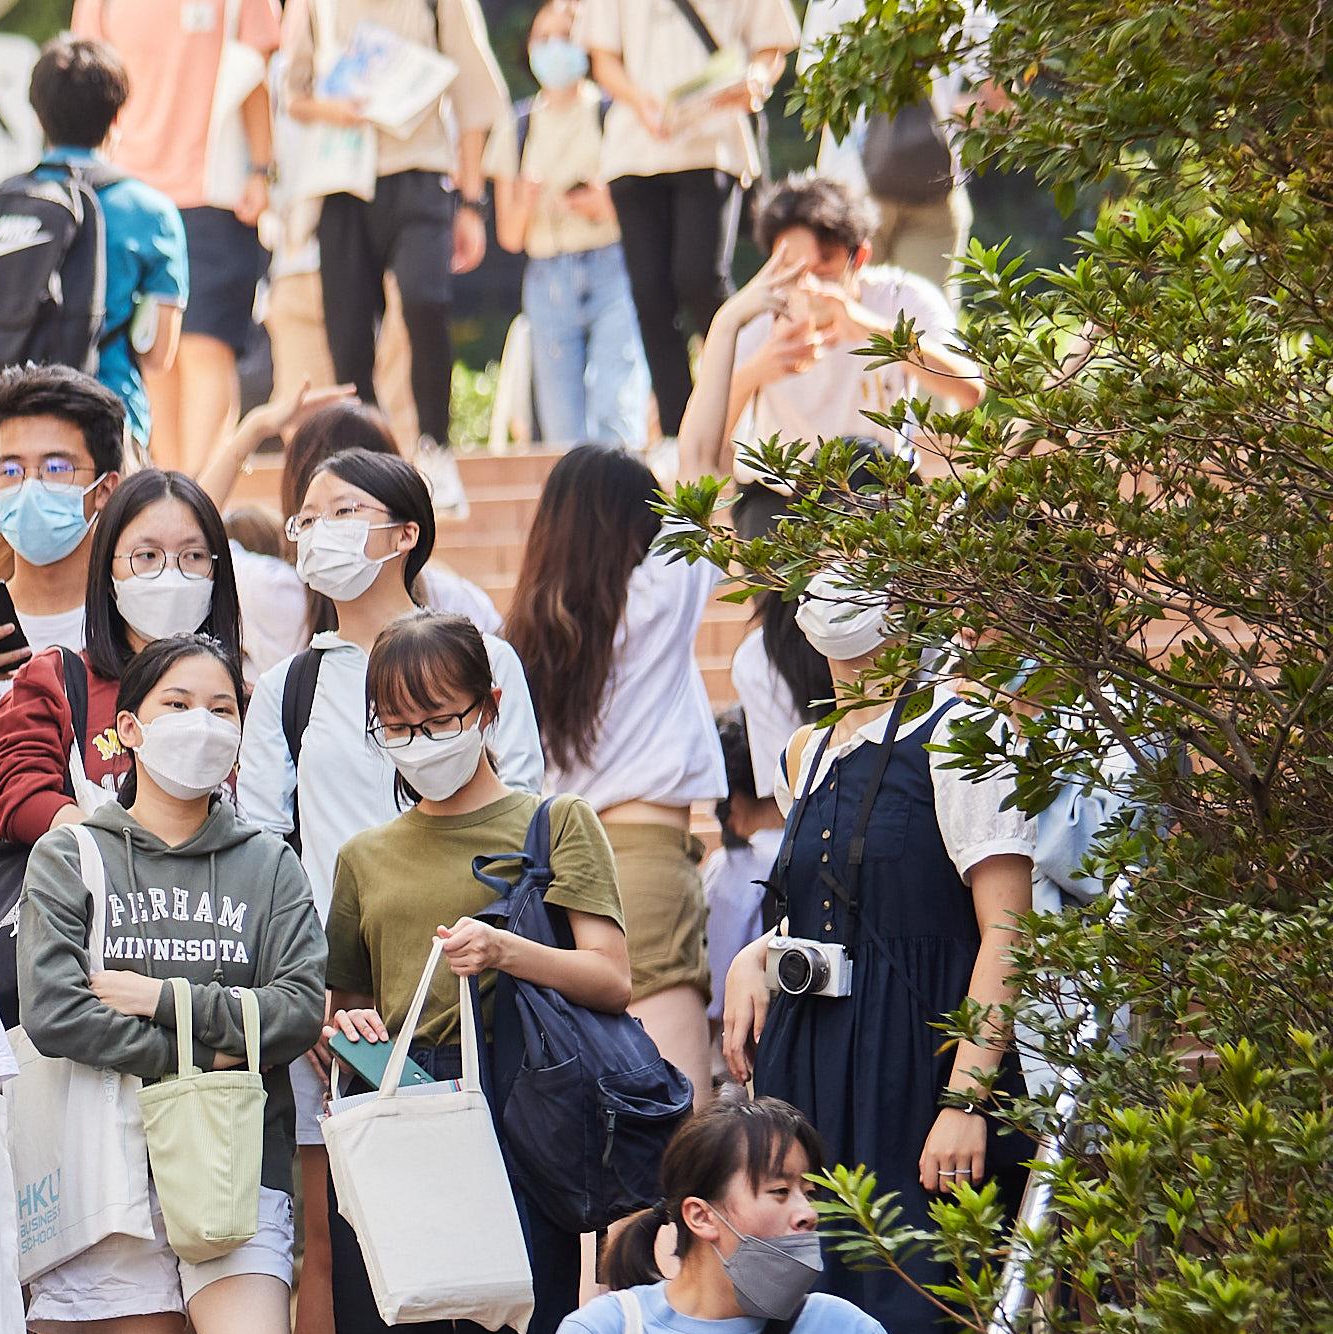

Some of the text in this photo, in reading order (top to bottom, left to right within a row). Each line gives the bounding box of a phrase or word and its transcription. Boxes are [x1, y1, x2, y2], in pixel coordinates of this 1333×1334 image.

[108, 886, 248, 934] PERHAM
[104, 936, 249, 964] MINNESOTA
[18, 1167, 61, 1220] HKU
[20, 1224, 58, 1255] SCHOOL
